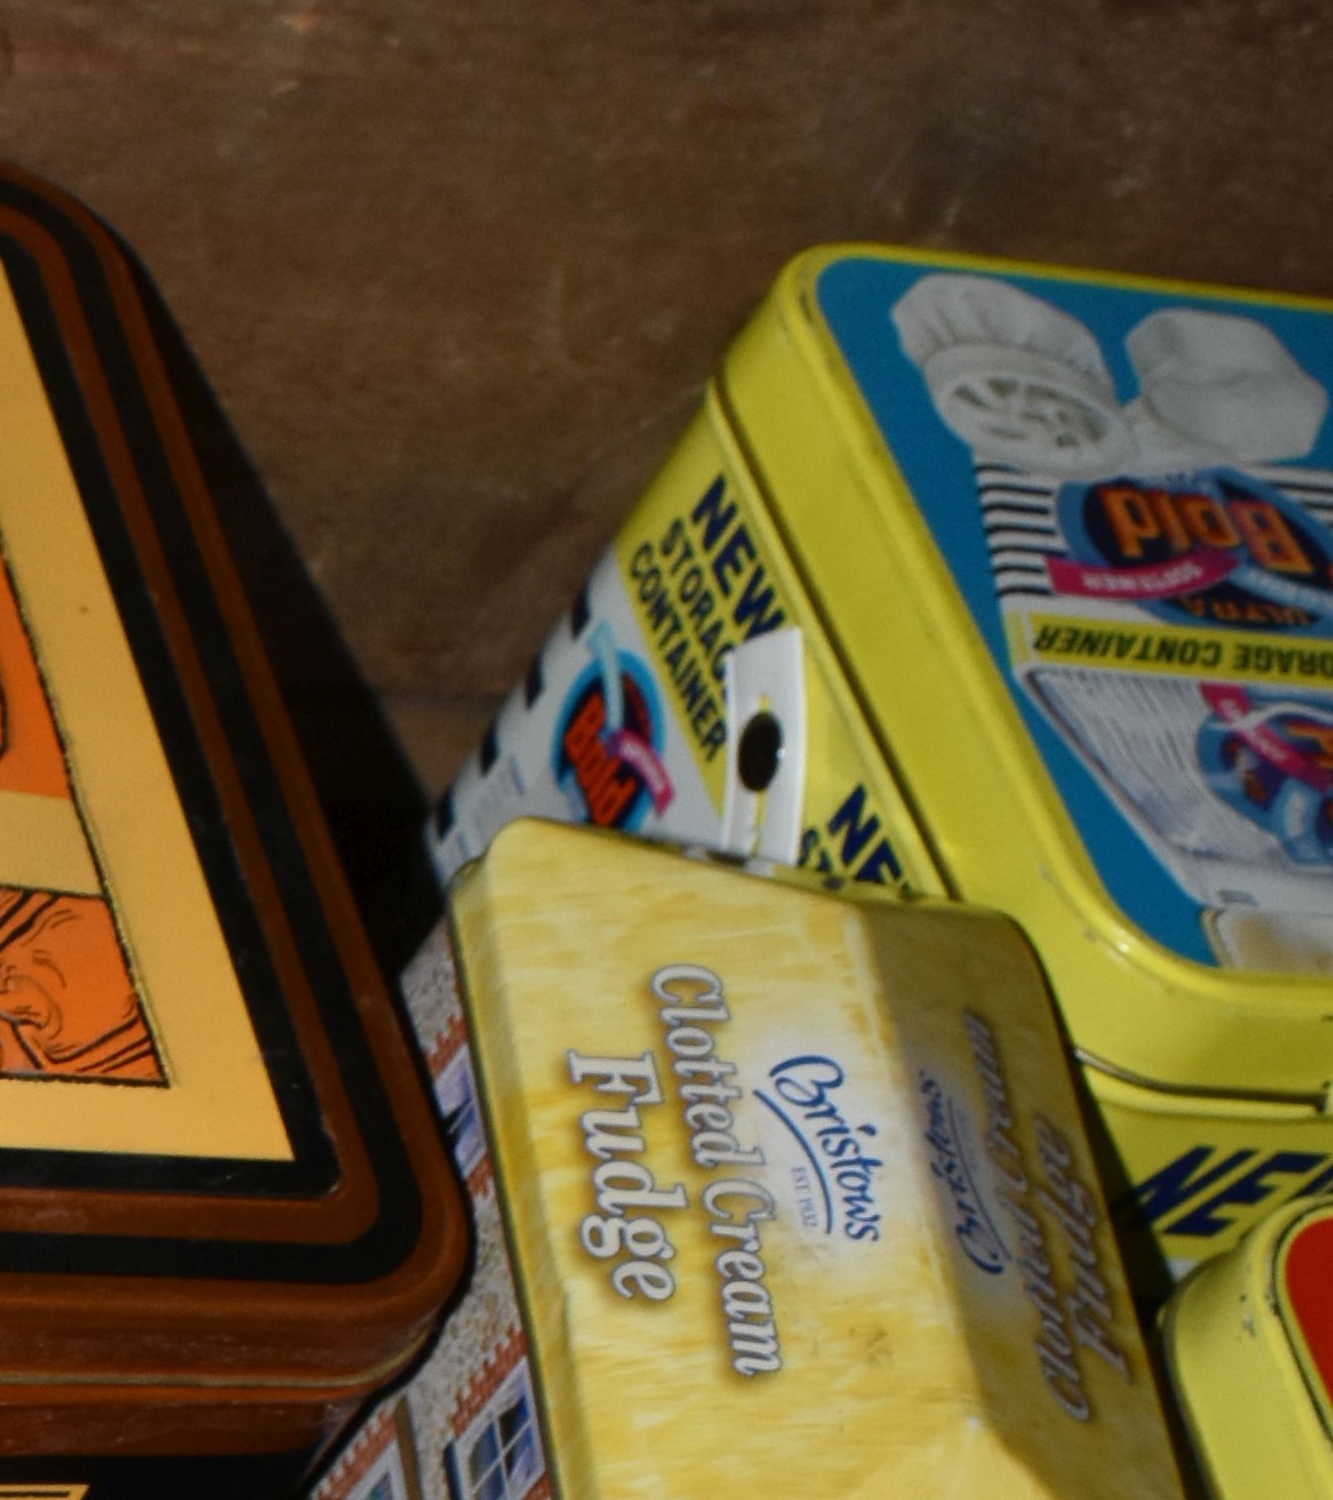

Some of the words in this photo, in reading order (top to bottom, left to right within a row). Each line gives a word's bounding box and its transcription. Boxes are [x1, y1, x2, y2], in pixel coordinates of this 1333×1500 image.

[661, 517, 738, 700] STORAG
[691, 473, 789, 641] NEW
[1096, 484, 1316, 575] Bold
[630, 540, 728, 764] CONTAINER
[1035, 623, 1223, 668] CONTAINER
[650, 962, 765, 1169] Clotted
[769, 1055, 884, 1244] Bristows
[565, 1049, 689, 1303] Fudge
[1135, 1145, 1333, 1238] NE
[701, 1177, 783, 1377] Cream
